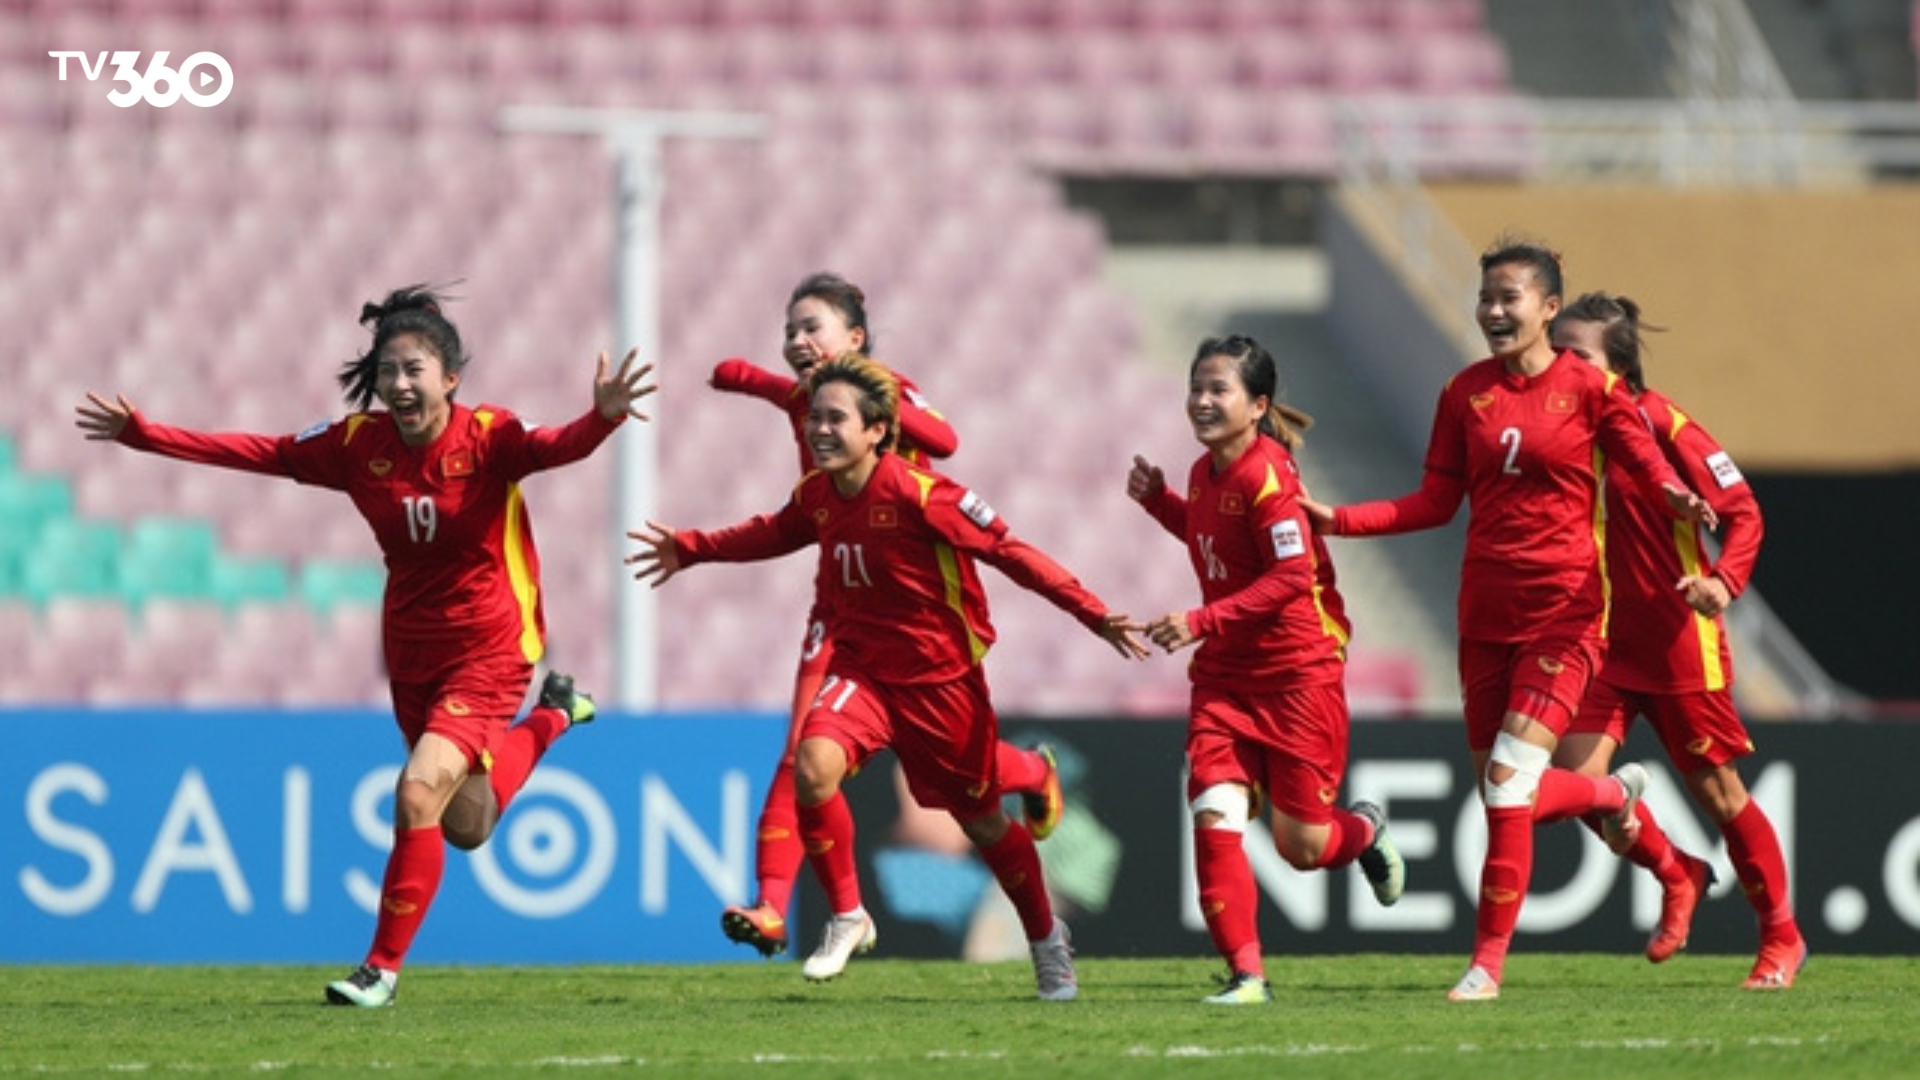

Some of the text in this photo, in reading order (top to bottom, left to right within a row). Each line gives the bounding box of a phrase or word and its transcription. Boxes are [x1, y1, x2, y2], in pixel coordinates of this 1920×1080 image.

[1500, 427, 1522, 474] 2
[402, 496, 437, 542] 19
[834, 543, 873, 587] 21
[811, 675, 858, 711] 21
[19, 763, 749, 917] SAISON
